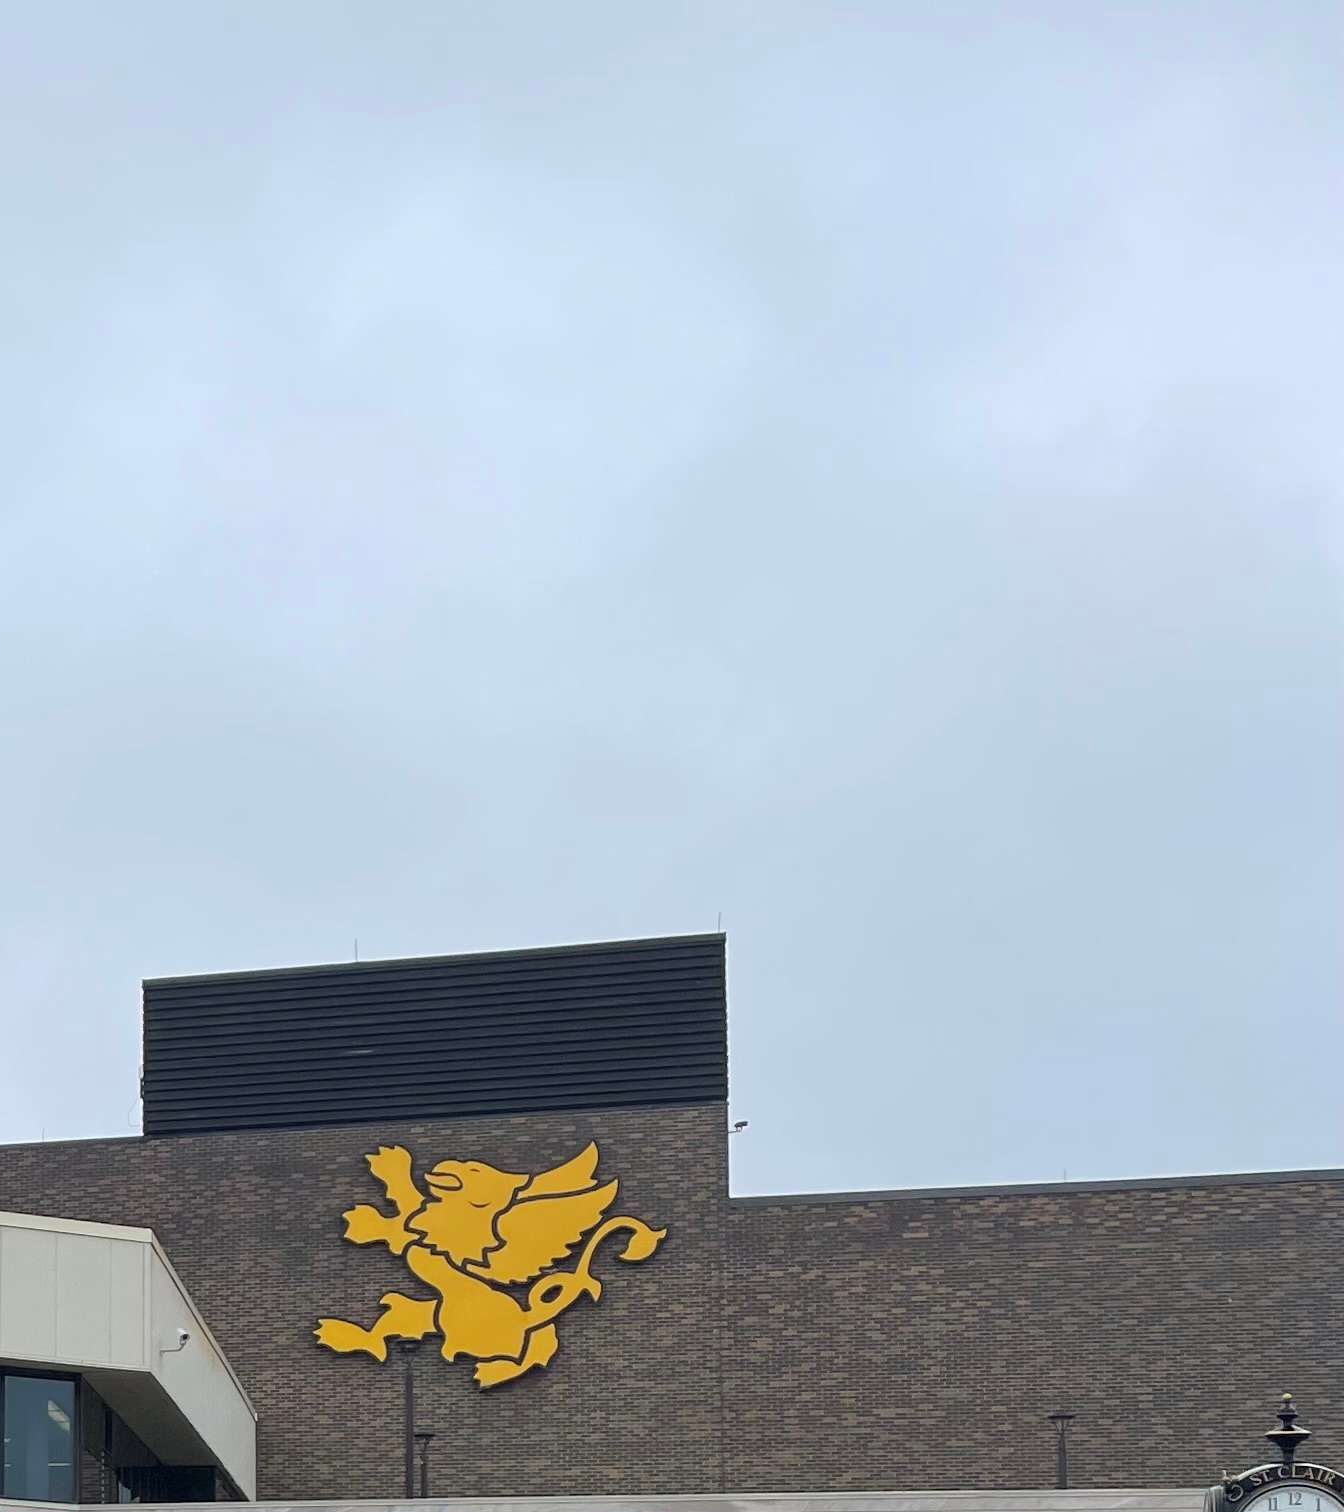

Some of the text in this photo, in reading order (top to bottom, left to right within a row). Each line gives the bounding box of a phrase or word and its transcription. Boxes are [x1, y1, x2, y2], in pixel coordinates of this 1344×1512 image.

[1278, 1464, 1336, 1486] CLAIR
[1268, 1497, 1278, 1511] 11
[1288, 1492, 1302, 1506] 12
[1315, 1498, 1321, 1511] 1
